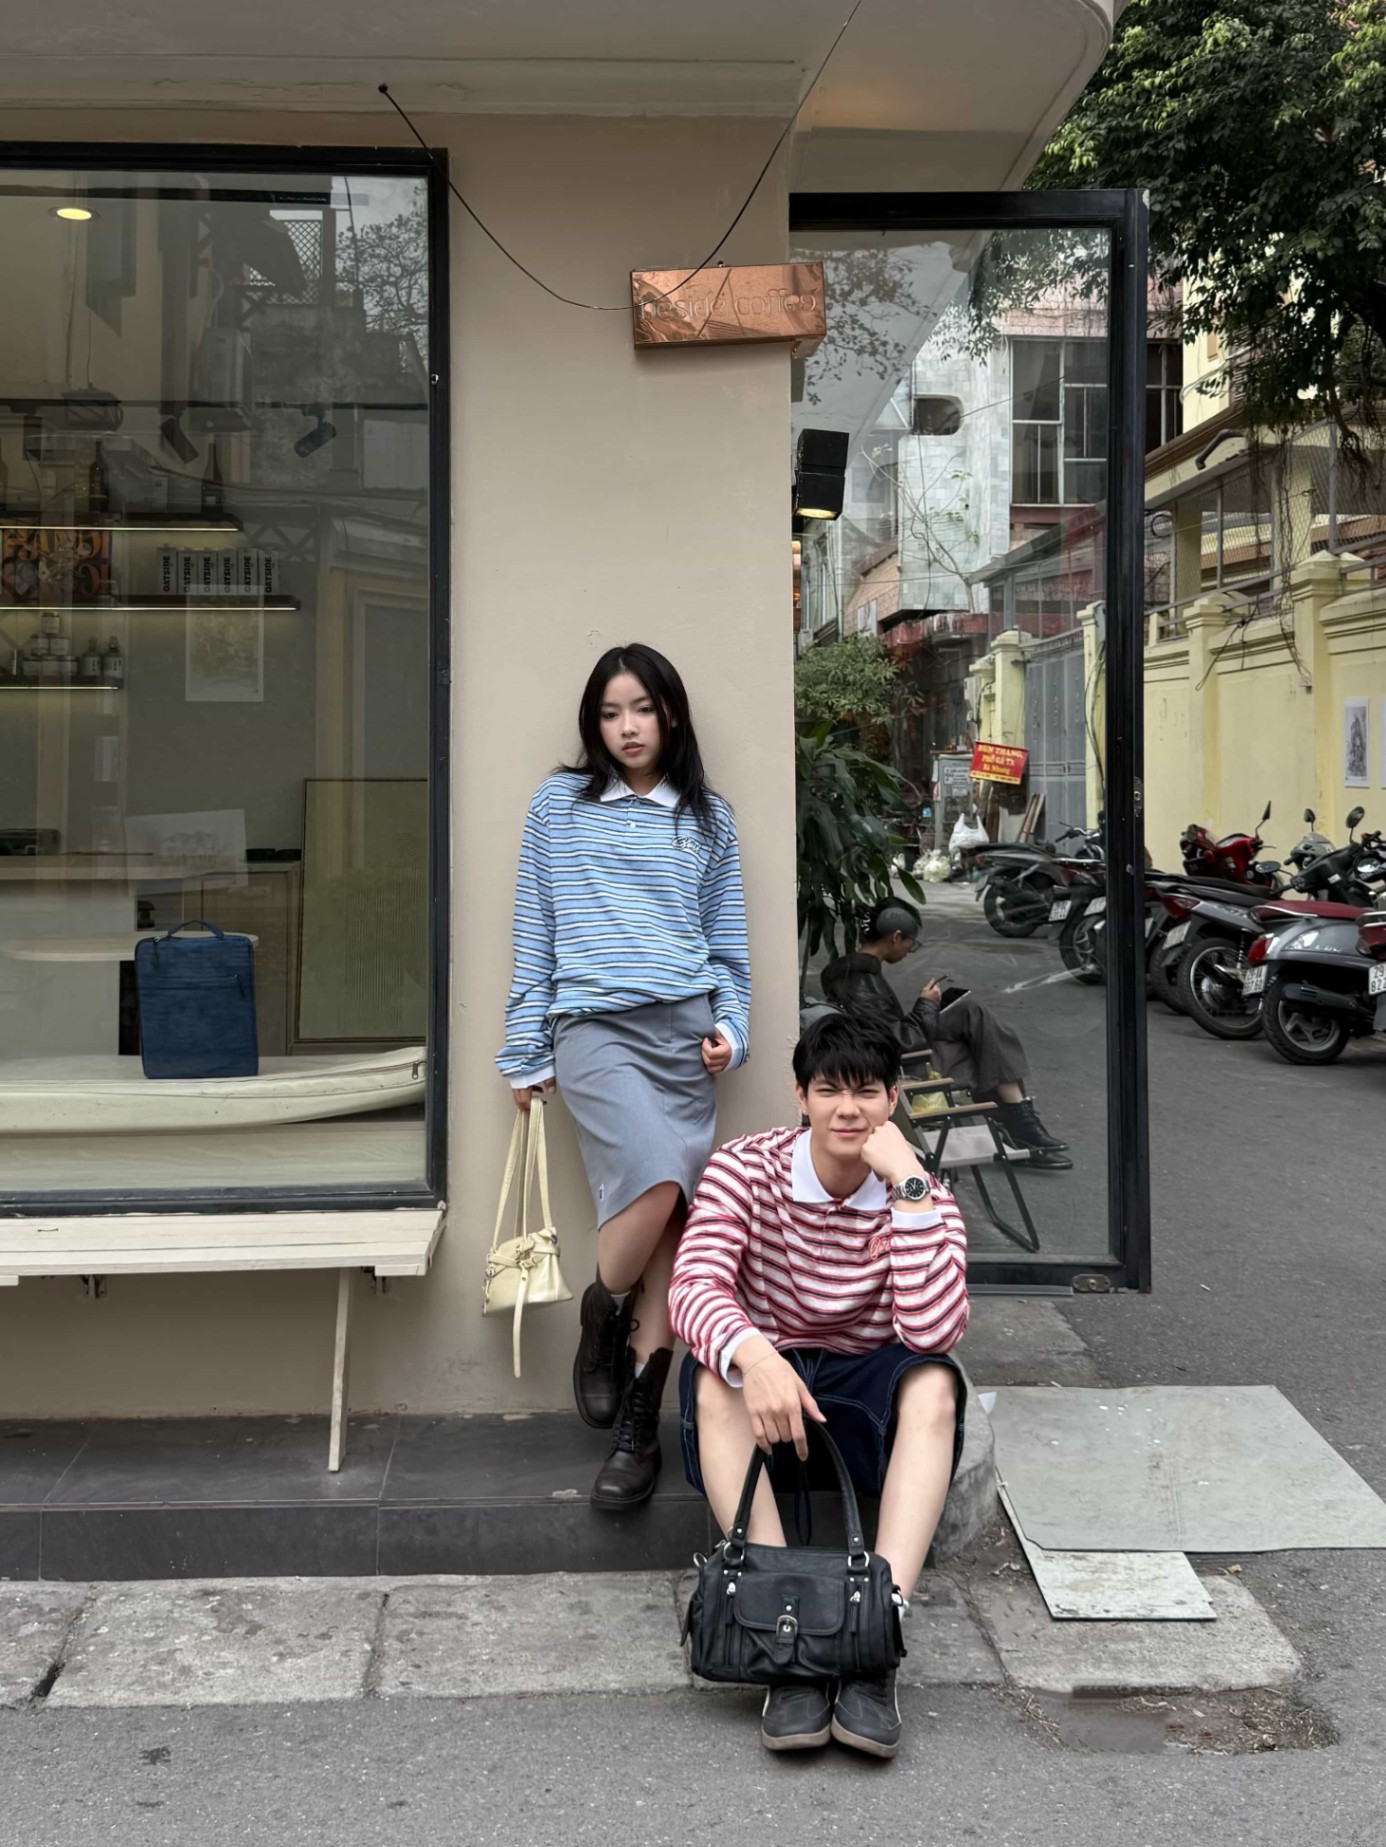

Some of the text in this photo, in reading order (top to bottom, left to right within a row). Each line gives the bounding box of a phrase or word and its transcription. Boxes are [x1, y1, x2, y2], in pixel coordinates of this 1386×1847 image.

[163, 555, 171, 592] OATSIDE
[183, 556, 191, 593] OATSIDE
[203, 556, 211, 593] OATSIDE
